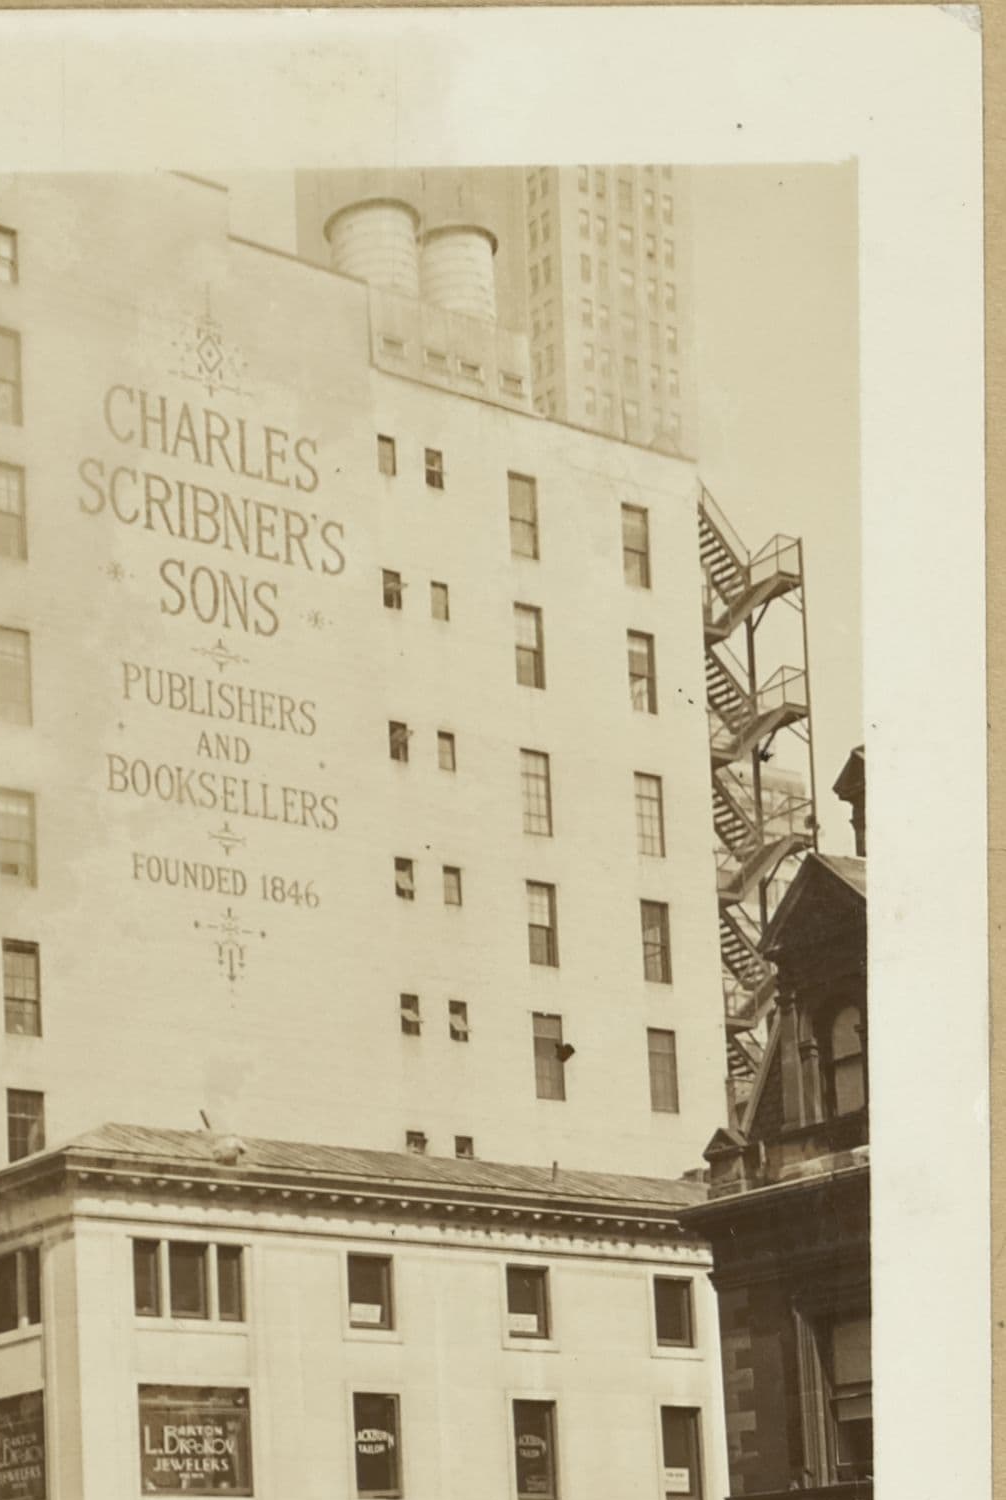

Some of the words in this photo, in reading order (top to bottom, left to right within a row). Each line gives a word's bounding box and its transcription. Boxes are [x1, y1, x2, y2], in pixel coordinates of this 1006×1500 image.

[103, 384, 319, 493] CHARLES
[78, 458, 346, 575] SCRIBNER'S
[159, 558, 279, 637] SONS
[122, 661, 316, 736] PUBLISHERS
[196, 732, 250, 765] AND
[106, 753, 339, 831] BOOKSELLERS
[133, 853, 246, 896] FOUNDED
[261, 875, 319, 908] 1846
[153, 1458, 229, 1472] JEWELERS
